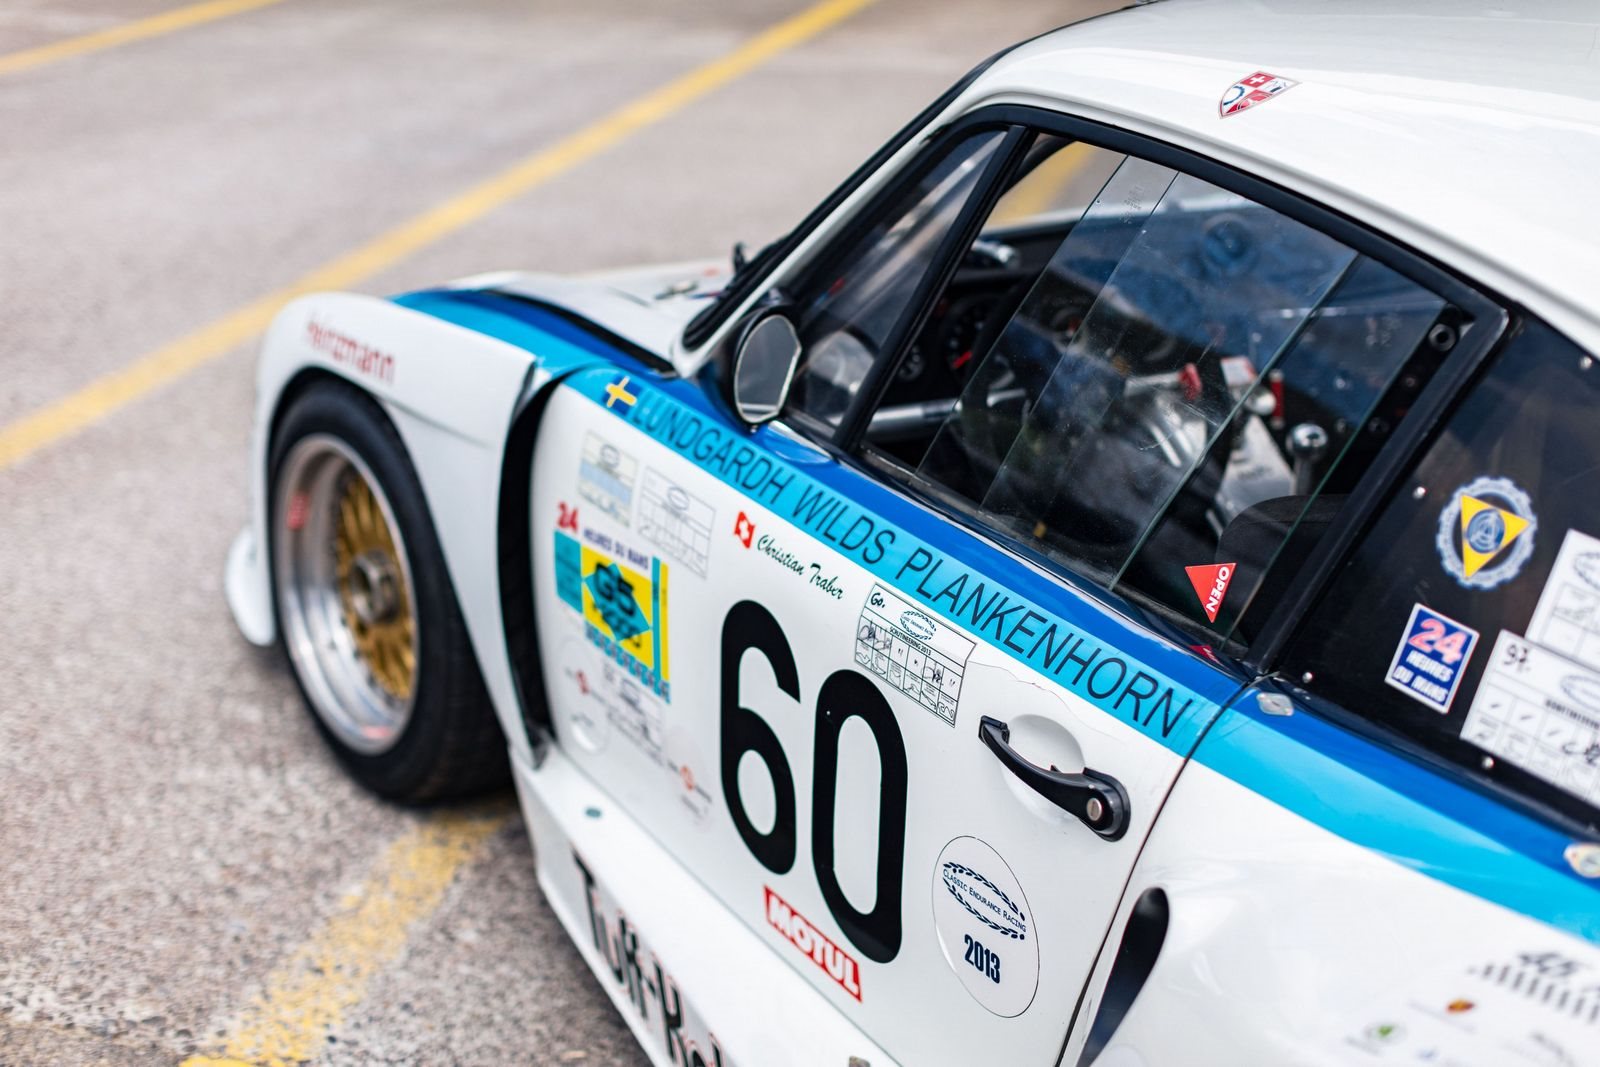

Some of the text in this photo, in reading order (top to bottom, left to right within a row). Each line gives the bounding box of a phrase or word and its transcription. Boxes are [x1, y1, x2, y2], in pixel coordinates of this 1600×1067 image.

[557, 501, 579, 534] 24
[593, 562, 635, 617] G5
[632, 389, 796, 501] LUNDGARDH
[792, 484, 896, 565] WILDS
[895, 547, 1193, 738] PLANKENHORN
[757, 534, 844, 600] Christian Traber
[1206, 566, 1230, 613] OPEN
[889, 626, 921, 650] SCRUTINEERING
[1408, 618, 1467, 664] 24
[1406, 650, 1454, 682] HEURES
[720, 599, 908, 964] 60
[943, 867, 1027, 933] CLASSIC ENDURANCE RACING
[767, 890, 859, 999] MOTUL
[964, 933, 1001, 985] 2013
